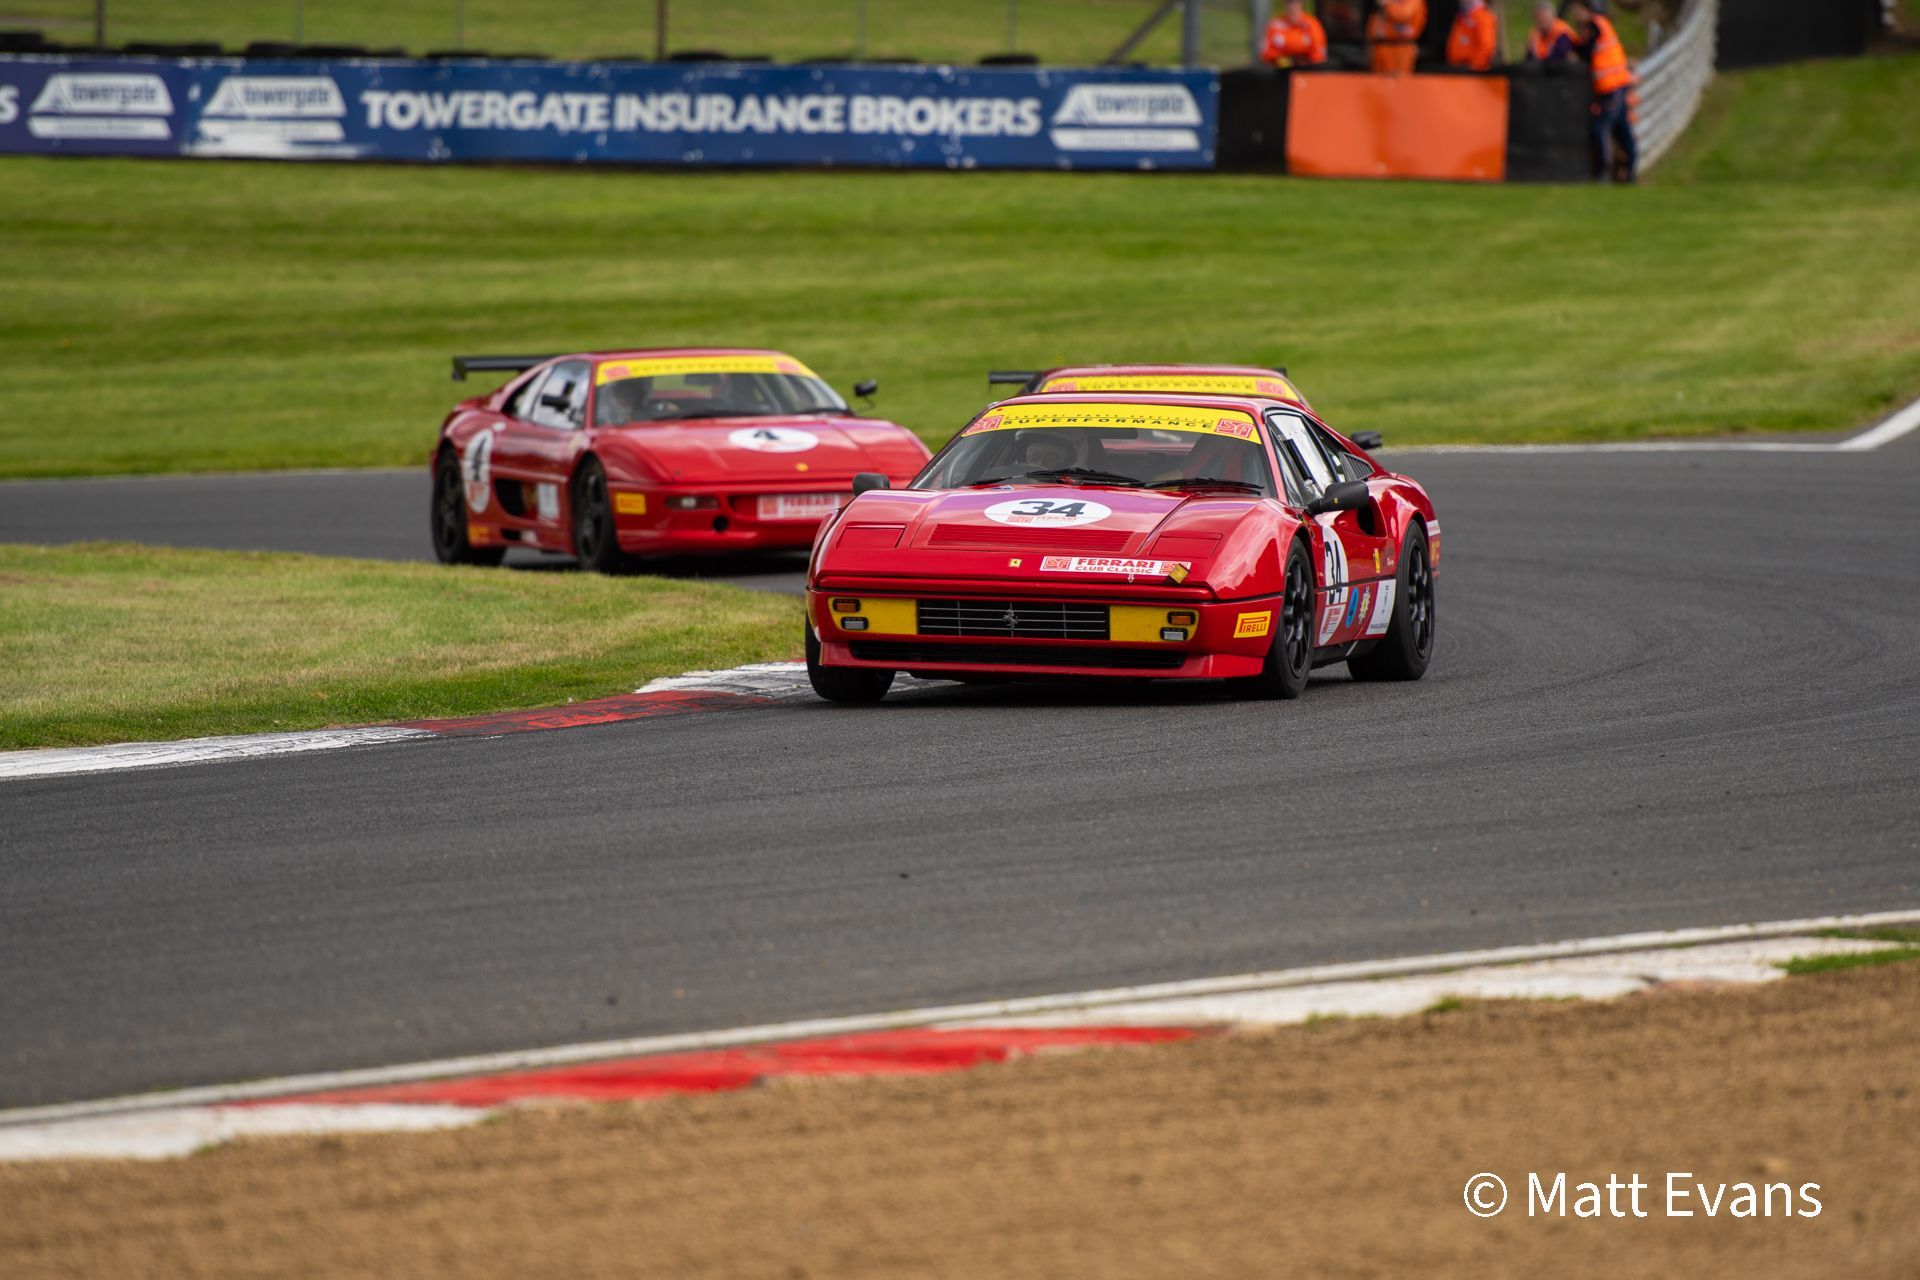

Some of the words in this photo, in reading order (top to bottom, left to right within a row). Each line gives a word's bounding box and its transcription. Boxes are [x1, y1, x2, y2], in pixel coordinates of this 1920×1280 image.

[361, 91, 610, 131] TOWERGATE
[613, 94, 846, 133] INSURANCE
[850, 96, 1041, 136] BROKERS
[1003, 417, 1212, 429] SUPERFORMANCE
[1011, 501, 1087, 517] 34
[1077, 558, 1155, 568] FERRARI
[1238, 616, 1268, 633] PIRELLI
